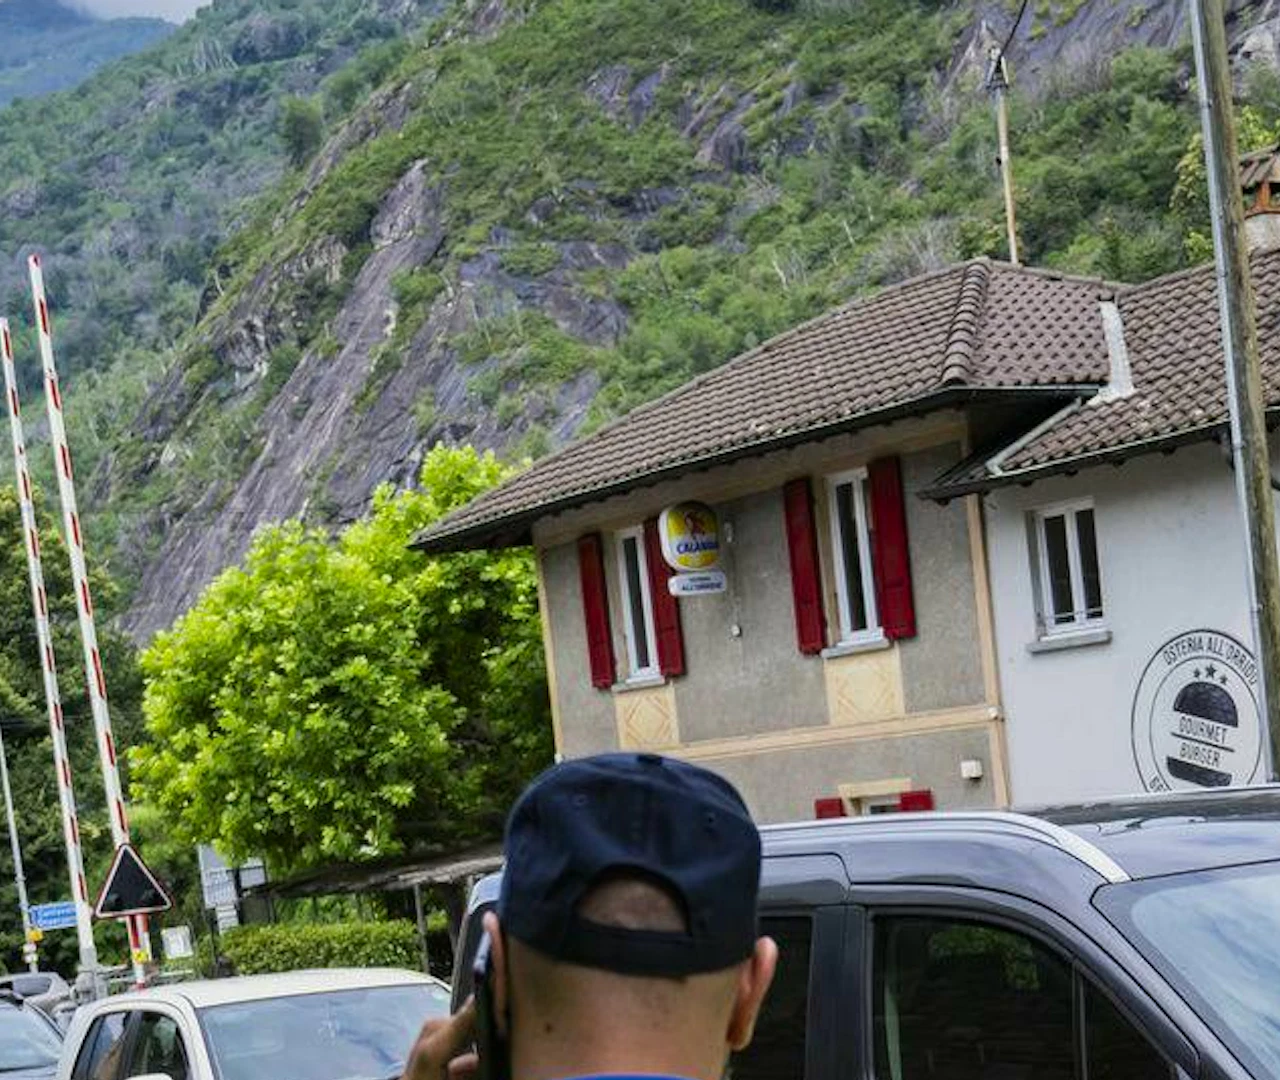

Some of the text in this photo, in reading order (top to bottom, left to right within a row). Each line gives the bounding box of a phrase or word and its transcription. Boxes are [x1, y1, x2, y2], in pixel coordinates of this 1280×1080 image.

[1163, 636, 1204, 666] OSTERIA
[1179, 716, 1228, 745] GOURMET
[1180, 742, 1222, 768] BURGER
